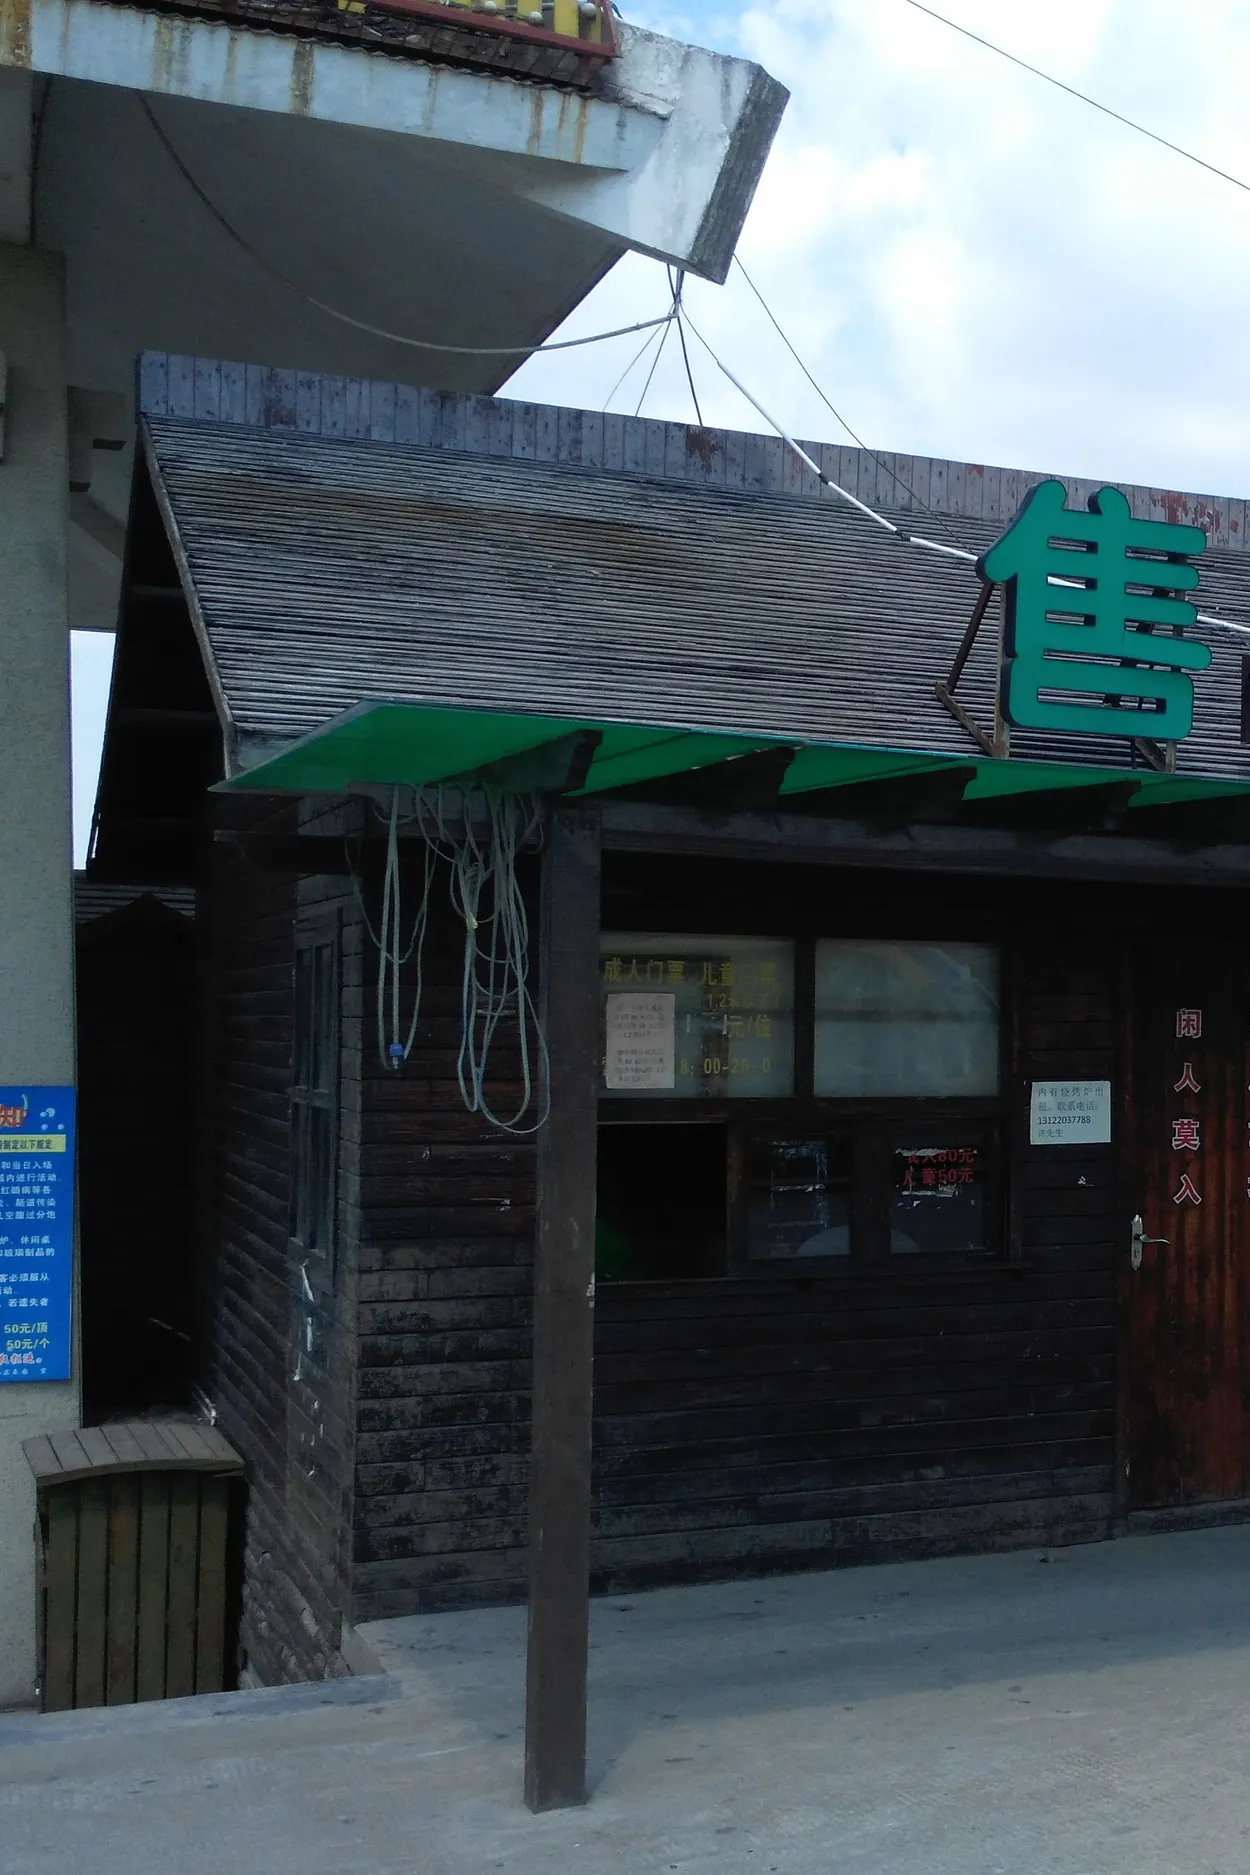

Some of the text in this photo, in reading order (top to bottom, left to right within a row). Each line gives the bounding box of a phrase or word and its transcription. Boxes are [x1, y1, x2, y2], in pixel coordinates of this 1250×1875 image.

[976, 479, 1213, 740] 售
[603, 957, 685, 984] 成人门票
[1172, 1008, 1203, 1205] 闲人莫入
[1037, 1115, 1092, 1125] 13122037788
[4, 1322, 48, 1334] 50元/顶
[6, 1338, 50, 1350] 50元/个
